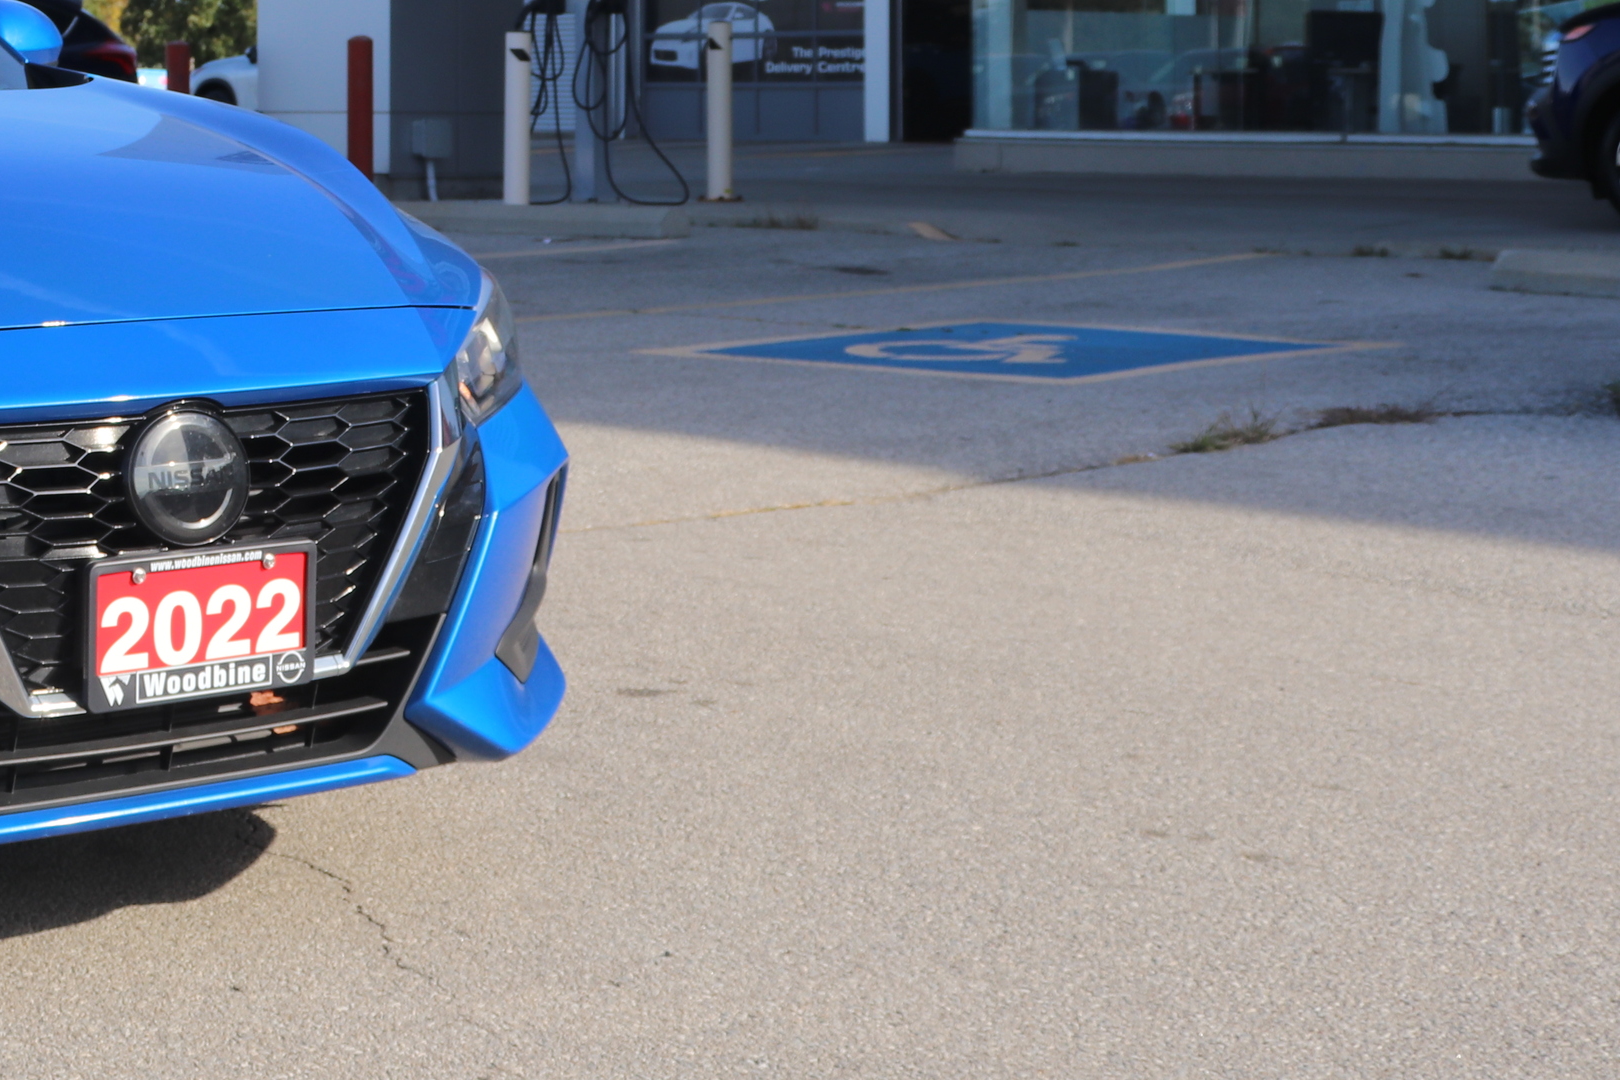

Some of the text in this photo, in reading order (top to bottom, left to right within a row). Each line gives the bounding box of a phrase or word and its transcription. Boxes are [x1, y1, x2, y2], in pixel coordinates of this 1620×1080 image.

[792, 46, 813, 58] The
[766, 62, 812, 75] Delivery
[150, 550, 262, 573] www.woodbinenissan.com
[100, 578, 301, 674] 2022
[143, 662, 266, 698] Woodbine
